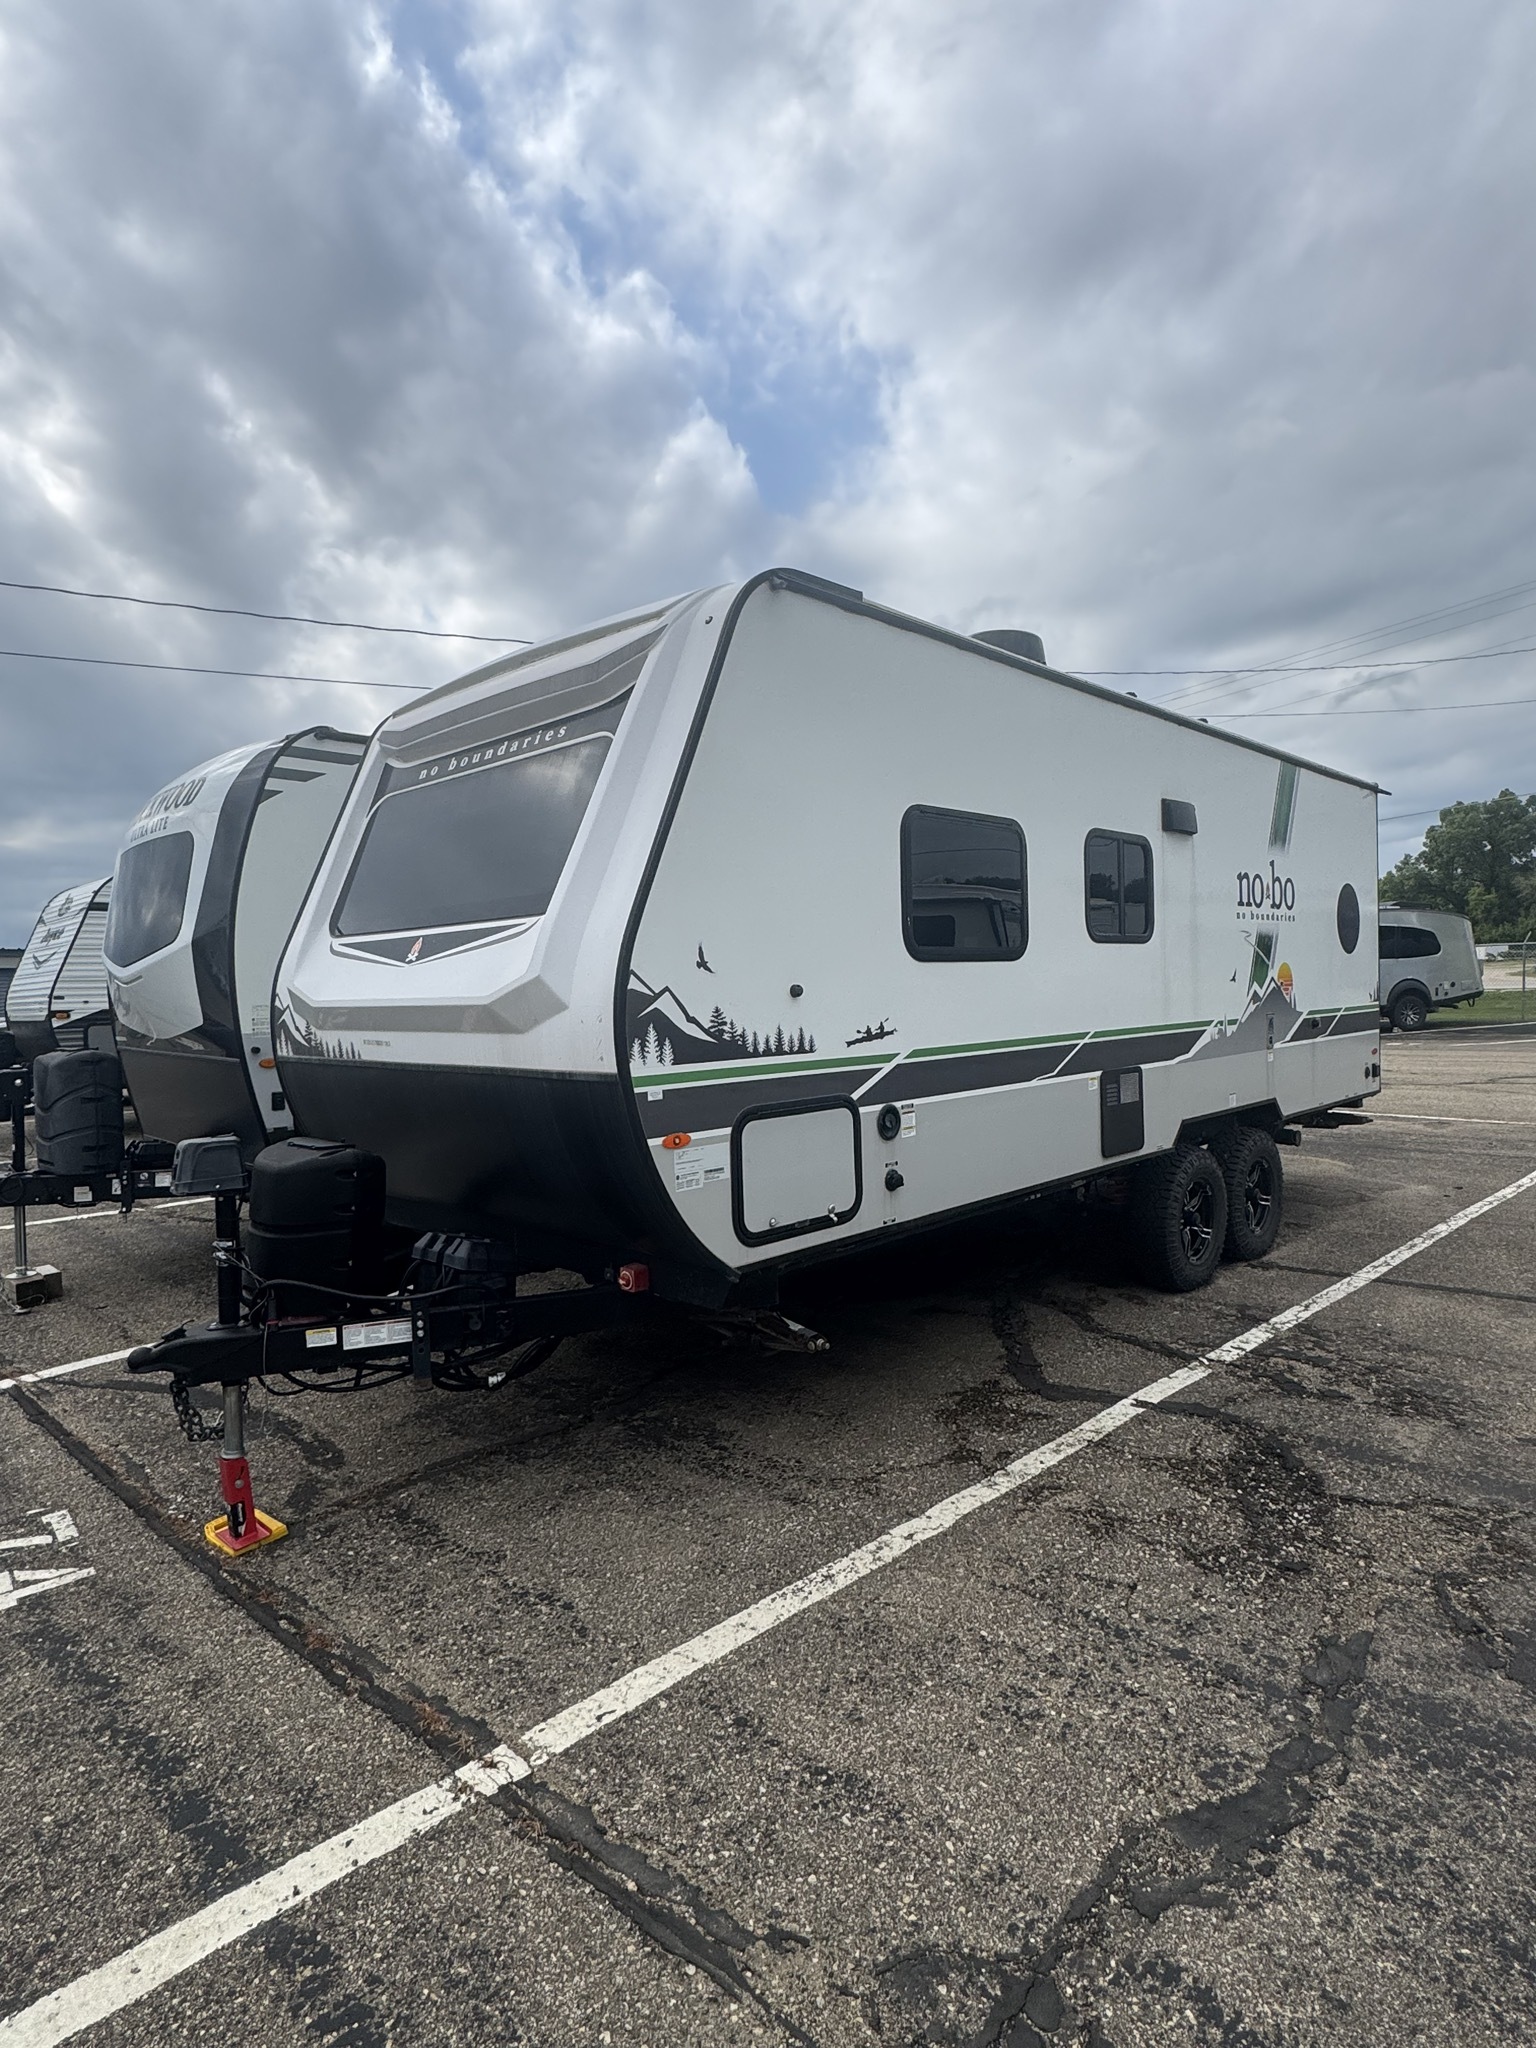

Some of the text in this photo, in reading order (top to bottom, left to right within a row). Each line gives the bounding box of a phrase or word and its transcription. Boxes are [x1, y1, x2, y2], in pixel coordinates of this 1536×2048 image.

[418, 725, 568, 780] no boundaries
[1236, 910, 1296, 922] no boundaries
